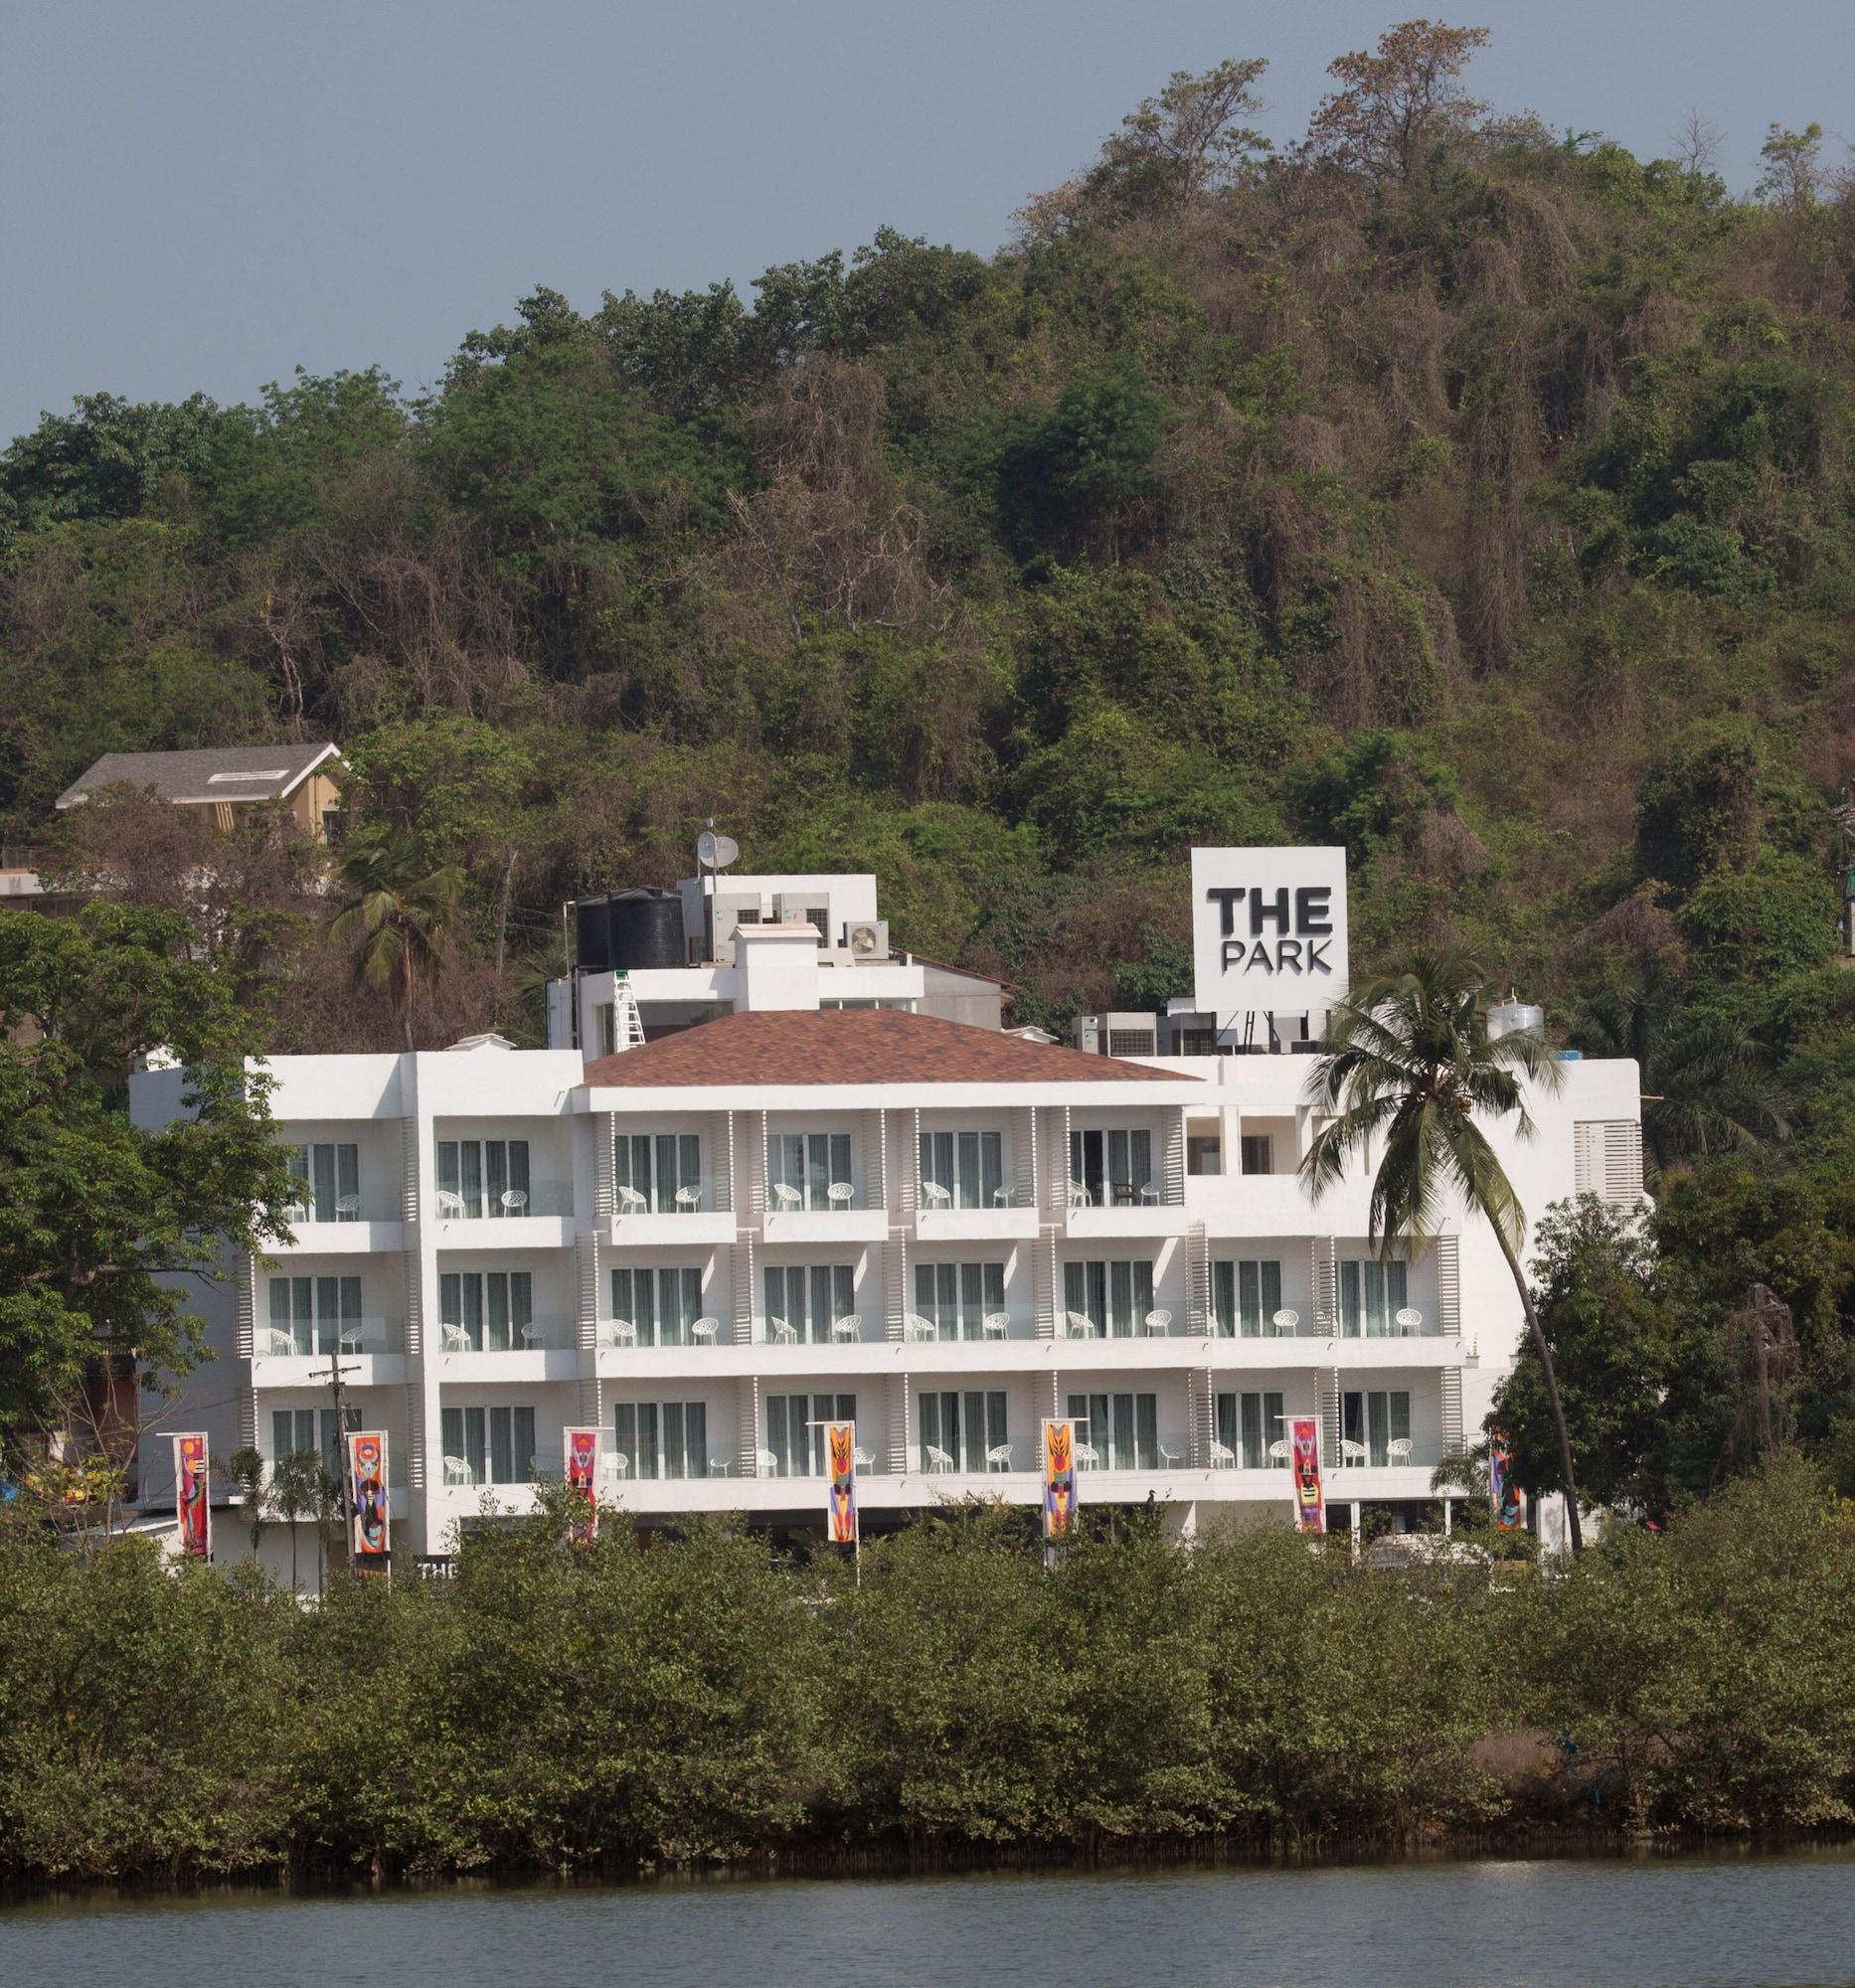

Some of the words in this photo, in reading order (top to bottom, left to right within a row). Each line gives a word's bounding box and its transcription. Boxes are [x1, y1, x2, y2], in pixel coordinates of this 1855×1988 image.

[1207, 887, 1333, 934] THE
[1222, 939, 1333, 973] PARK
[418, 1563, 458, 1579] THE
